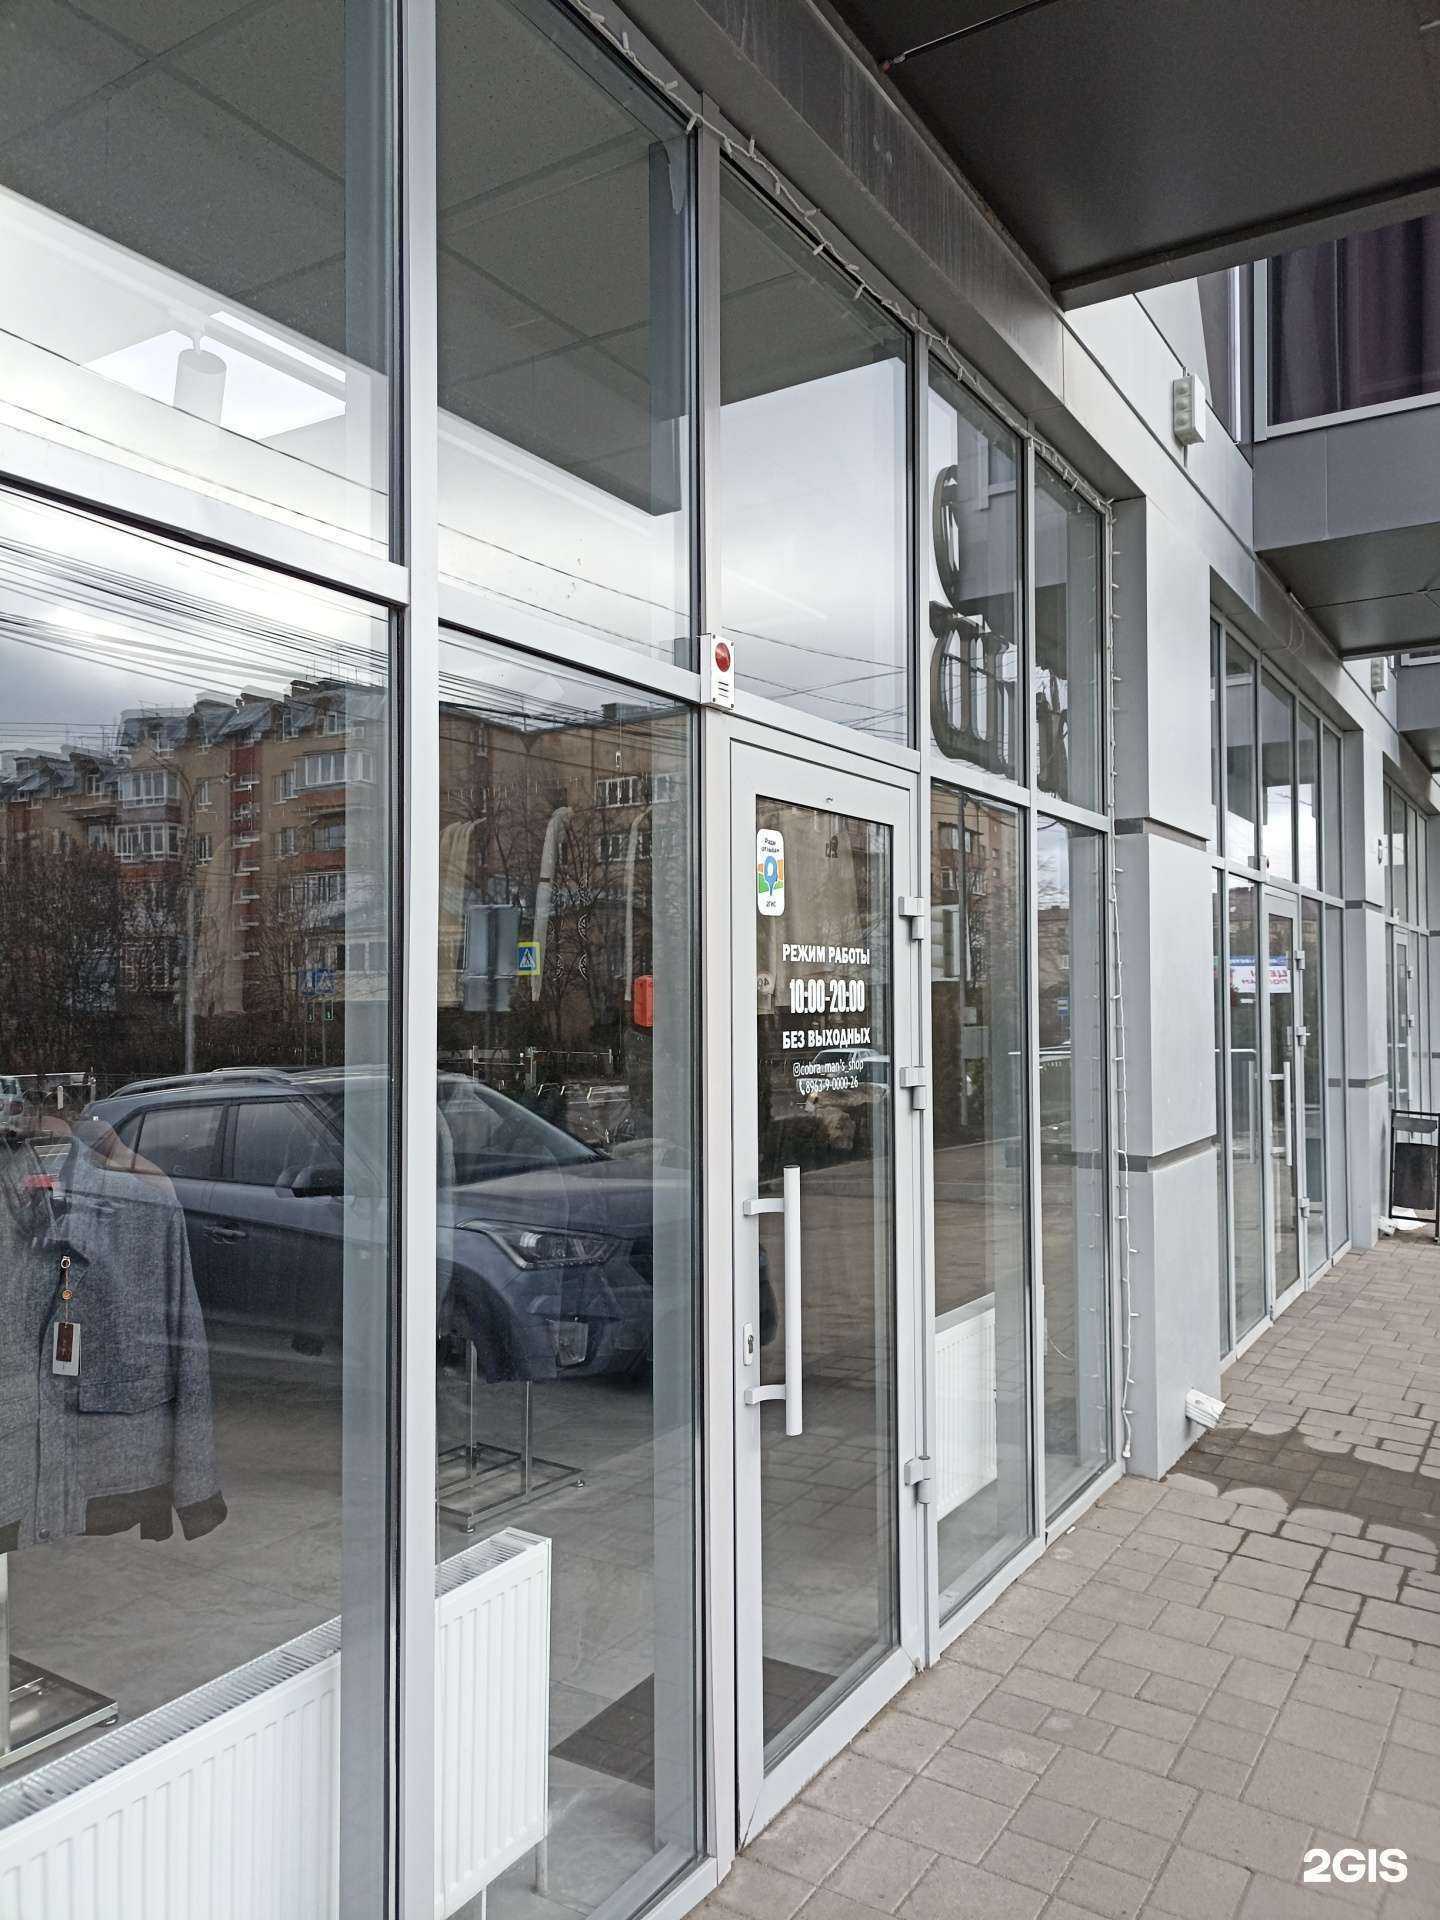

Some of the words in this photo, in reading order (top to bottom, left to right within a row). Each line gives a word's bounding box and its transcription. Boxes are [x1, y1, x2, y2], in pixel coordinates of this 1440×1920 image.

[782, 943, 826, 963] РЕЖИМ
[828, 946, 870, 965] РАБОТЫ
[789, 978, 865, 1014] 10:00-20:00
[782, 1029, 805, 1050] БЕЗ
[807, 1027, 871, 1048] ВЫХОДНЫХ
